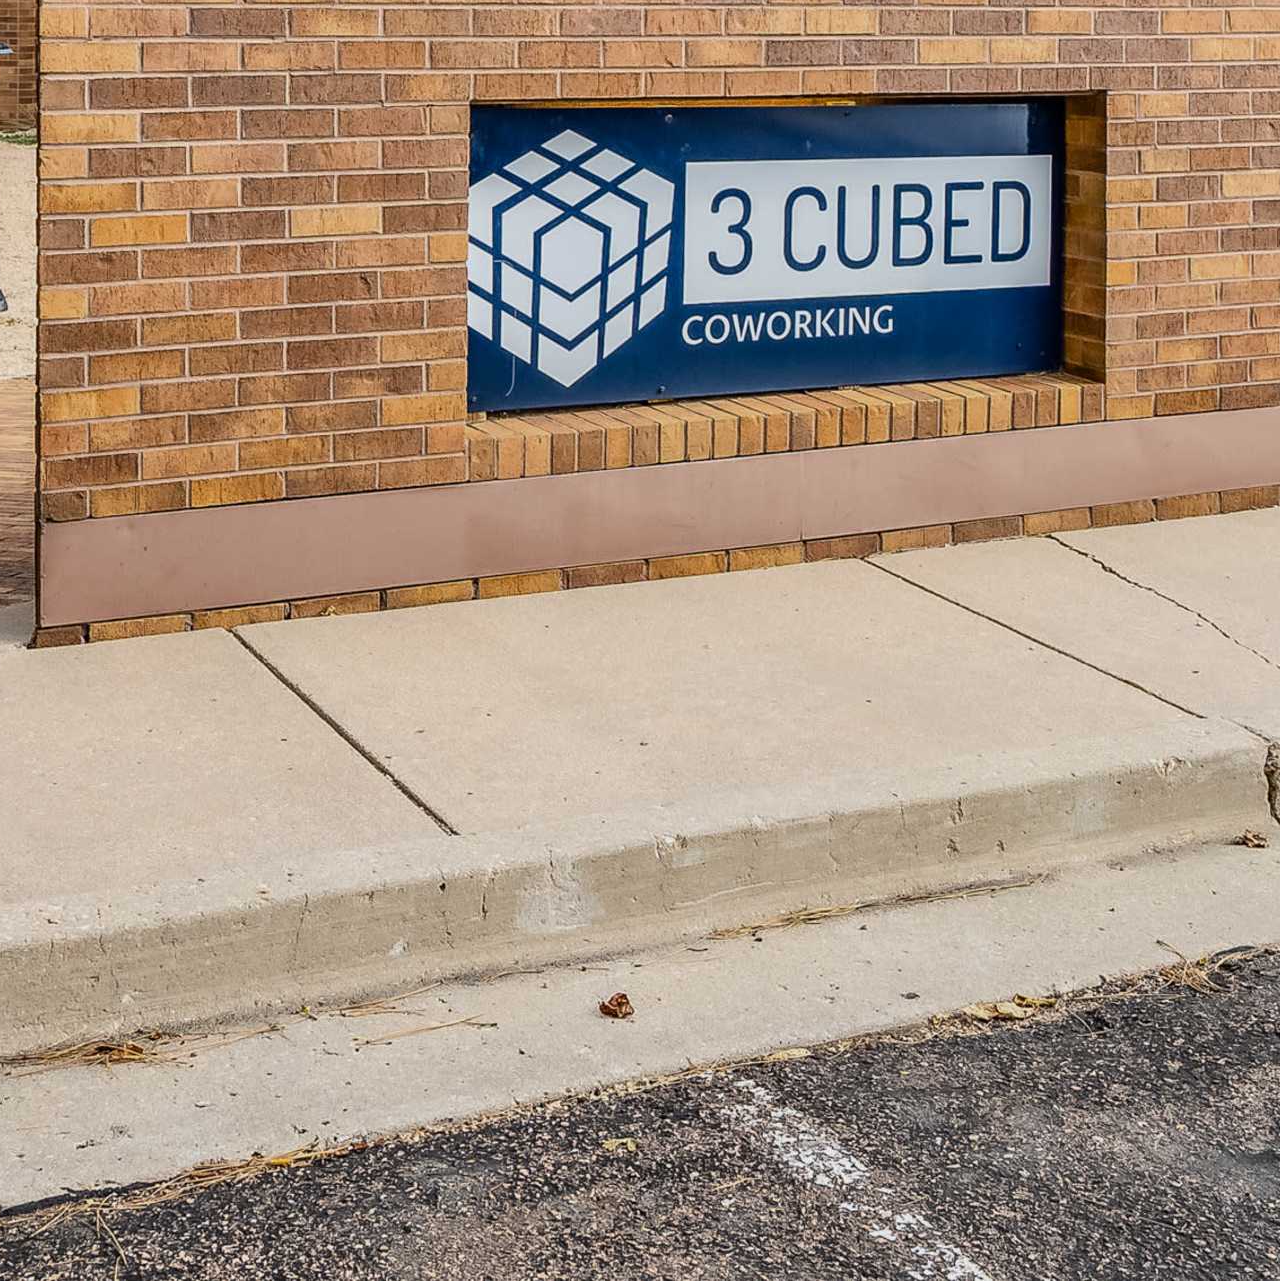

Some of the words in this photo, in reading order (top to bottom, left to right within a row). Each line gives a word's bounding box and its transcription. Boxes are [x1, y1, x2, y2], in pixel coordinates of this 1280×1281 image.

[707, 187, 754, 276] 3
[783, 180, 1032, 272] CUBED
[681, 305, 895, 346] COWORKING
